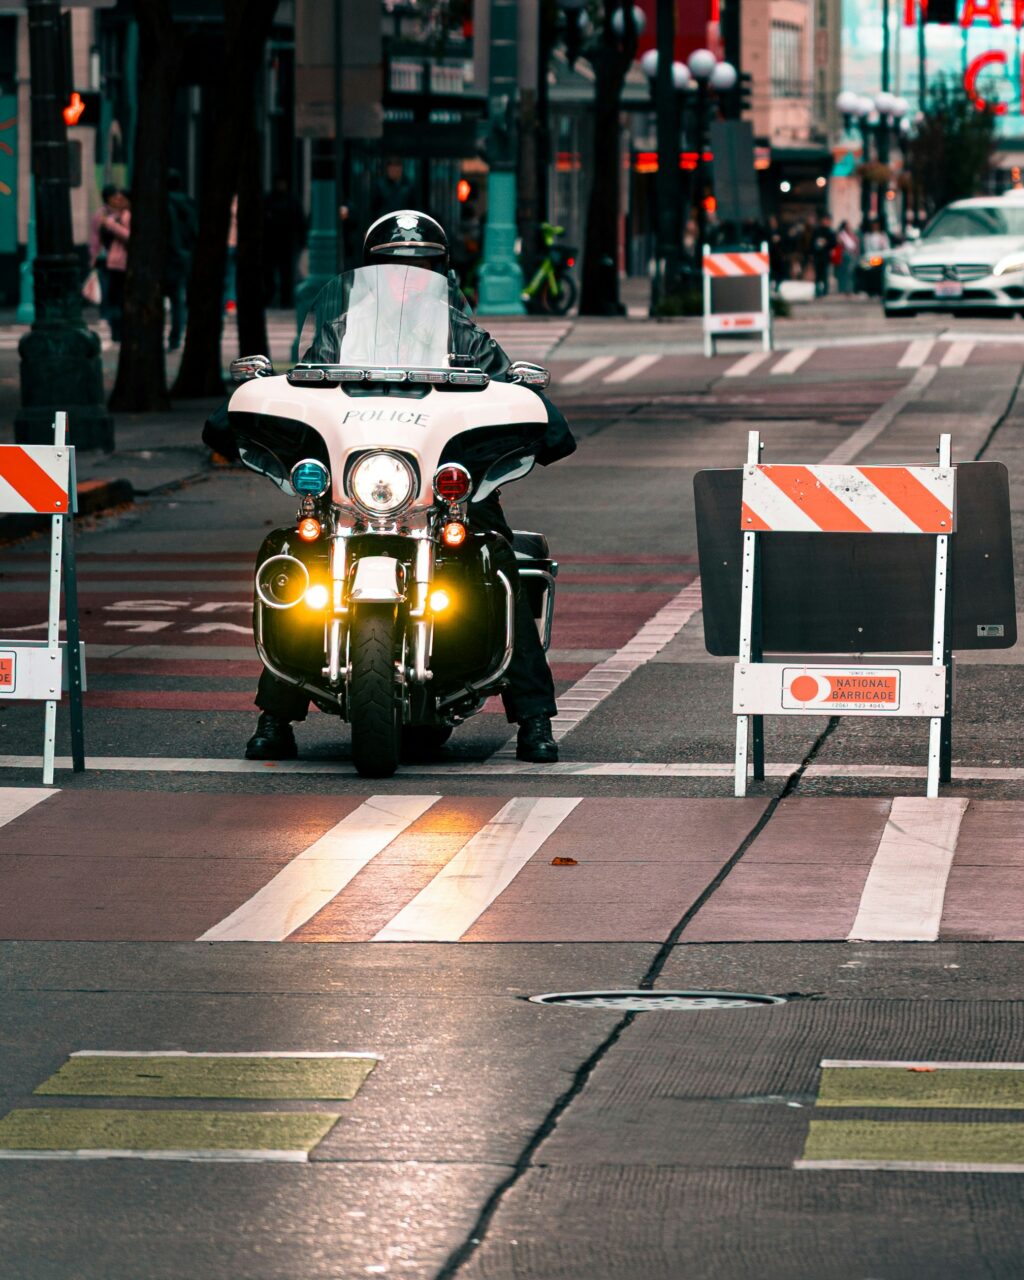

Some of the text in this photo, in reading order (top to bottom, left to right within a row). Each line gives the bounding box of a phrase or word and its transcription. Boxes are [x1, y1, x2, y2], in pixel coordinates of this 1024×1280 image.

[342, 410, 430, 428] POLICE
[836, 679, 890, 688] NATIONAL
[832, 691, 894, 700] BARRICADE
